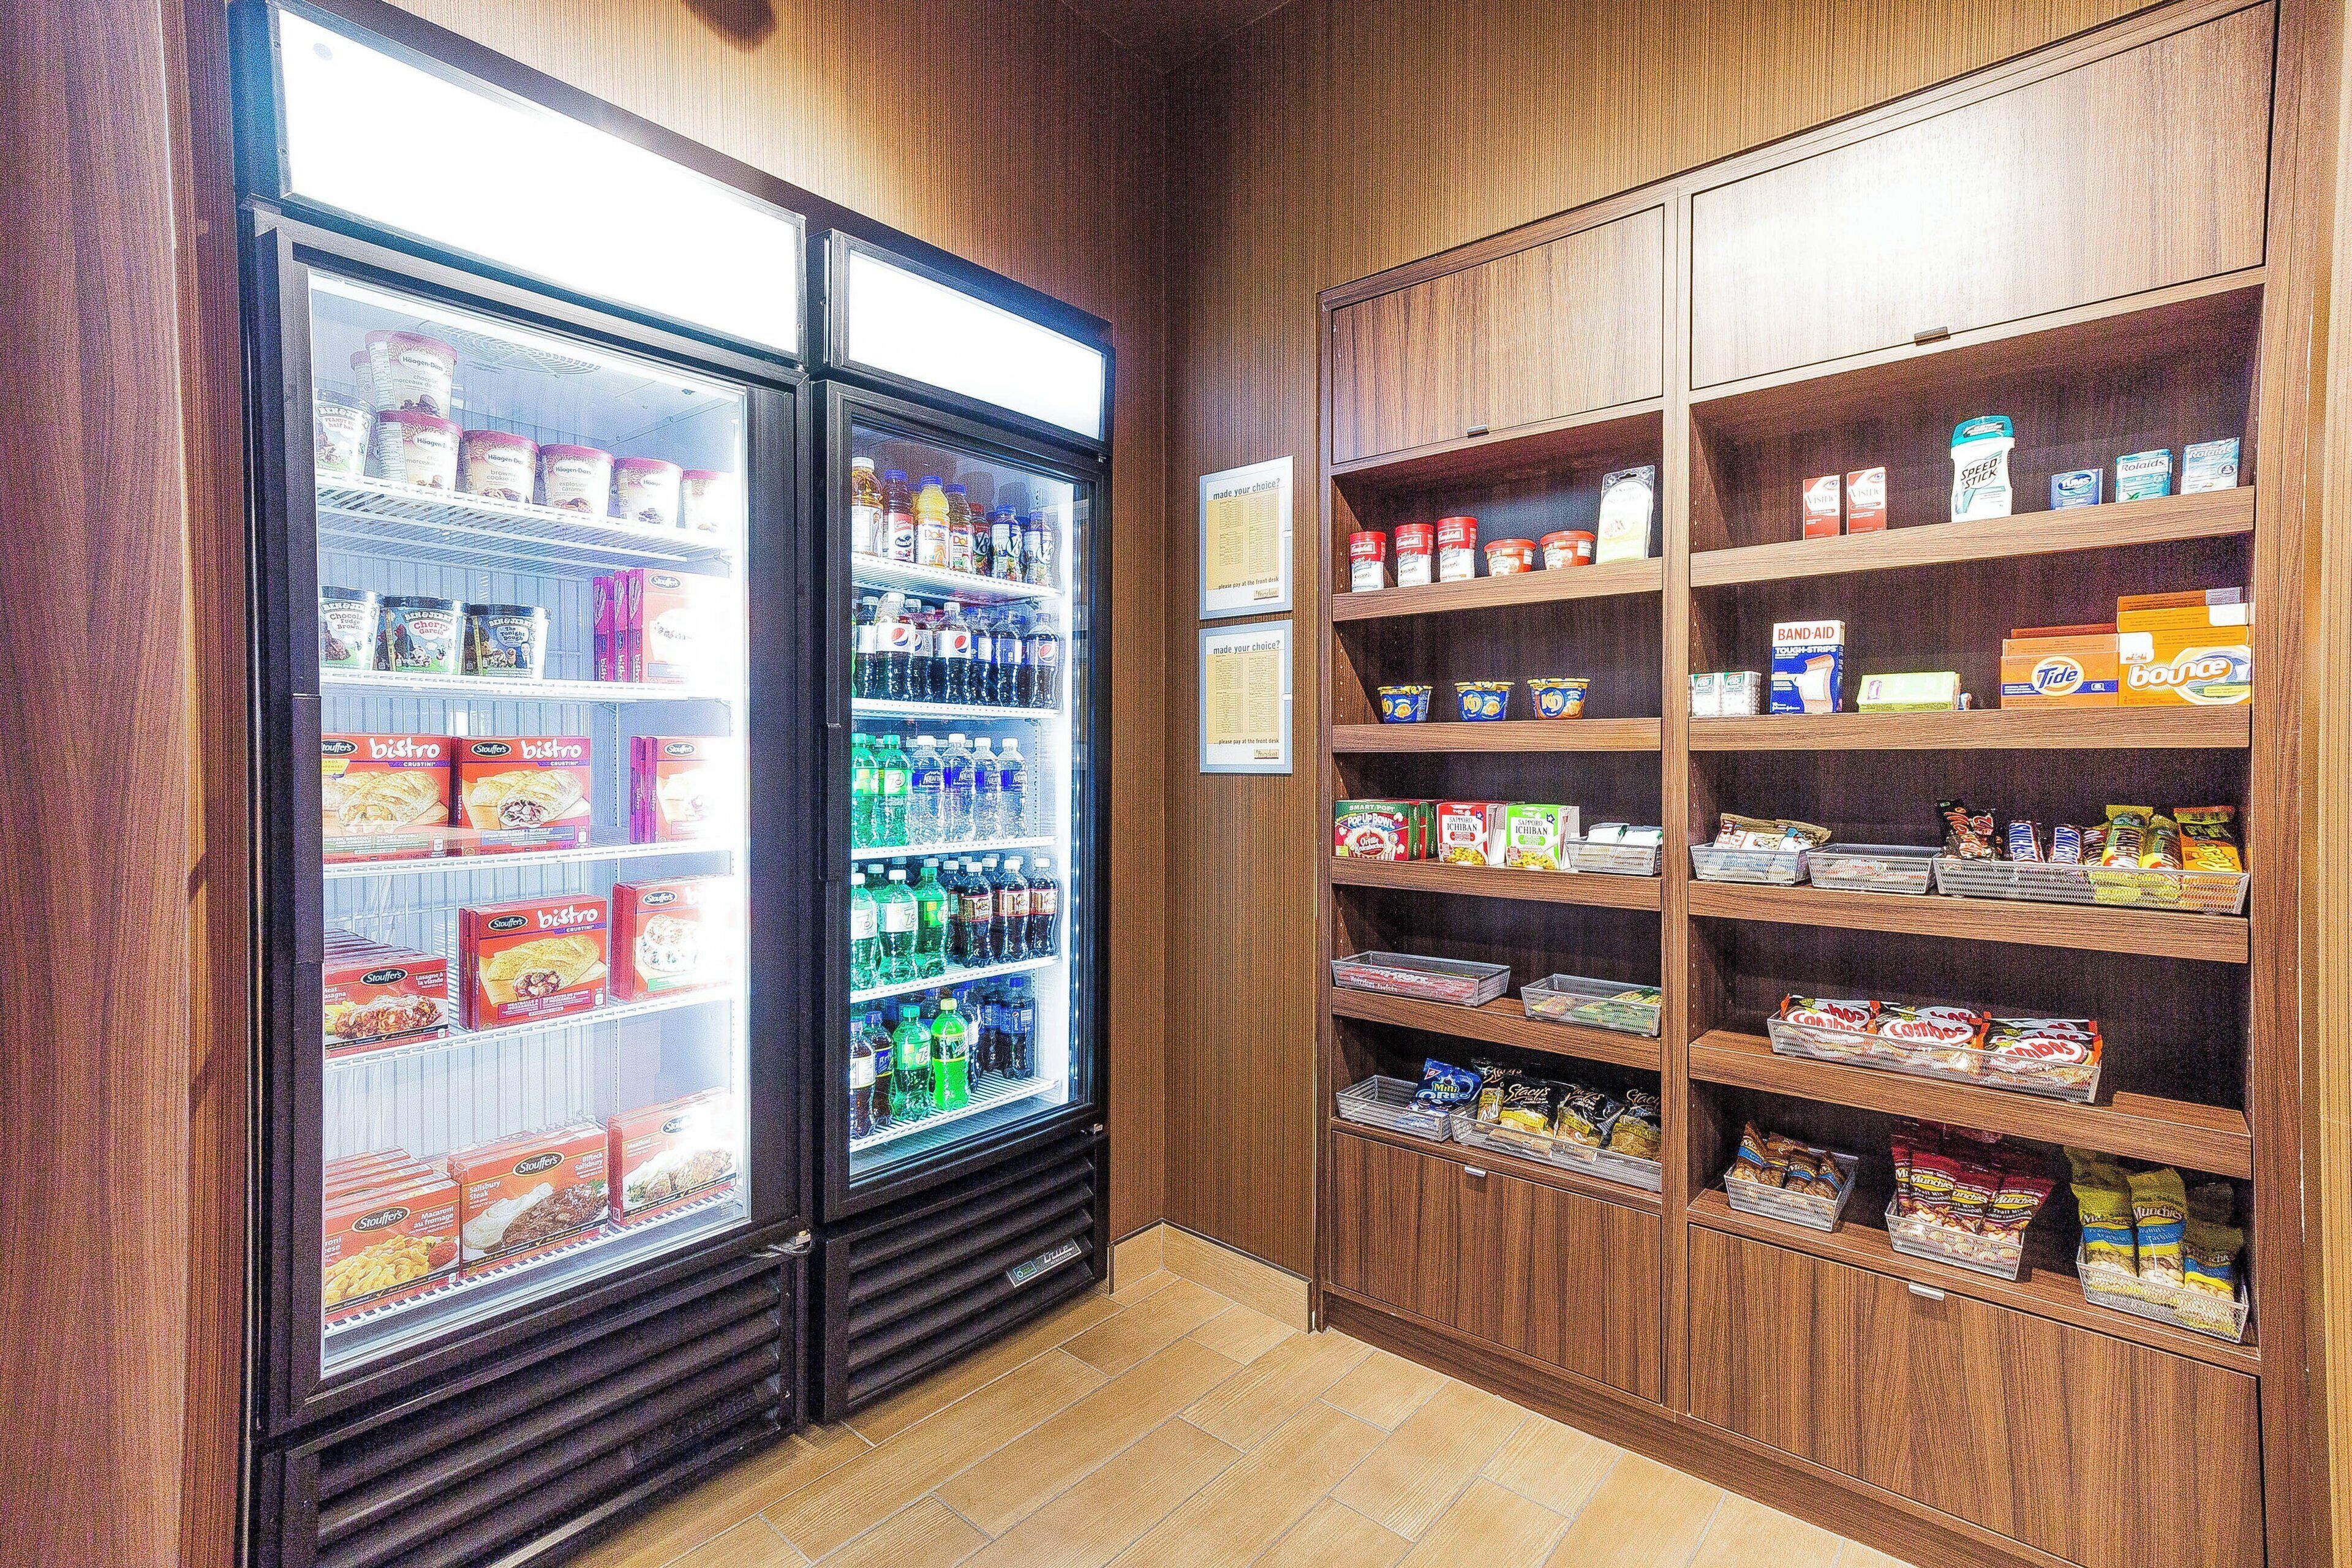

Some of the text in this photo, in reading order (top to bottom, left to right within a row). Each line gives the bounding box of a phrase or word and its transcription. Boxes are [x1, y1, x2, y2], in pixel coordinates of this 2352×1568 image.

[2189, 447, 2232, 459] Rolaids
[1961, 458, 1997, 481] SPEED
[2121, 459, 2166, 472] Rolaids
[1964, 467, 1998, 490] STICK
[2061, 477, 2091, 489] TUMS
[1213, 478, 1280, 500] made your choice?
[413, 620, 451, 632] Cherry
[1777, 627, 1834, 641] BAND-AID
[1213, 640, 1280, 655] made your choice?
[2037, 666, 2079, 690] Tide
[2129, 658, 2228, 687] bounce
[1463, 695, 1481, 712] KD
[1541, 693, 1562, 713] KD
[322, 742, 353, 755] touffer's
[369, 737, 441, 760] bistro
[476, 744, 508, 755] Stouffer's
[521, 739, 583, 760] bistro
[1348, 815, 1362, 827] POP
[1373, 815, 1395, 827] BOWL
[1447, 823, 1478, 832] ICHIBAN
[1515, 826, 1548, 835] ICHIBAN
[493, 917, 524, 929] Stouffer's
[537, 905, 599, 929] bistro
[366, 970, 402, 984] Stouffer's
[1415, 1090, 1469, 1099] OREO
[1434, 1083, 1458, 1093] Mini
[1504, 1084, 1551, 1102] Stacy's
[519, 1156, 558, 1173] Stouffer's
[469, 1182, 501, 1193] Salisbury
[1910, 1175, 1954, 1191] Munchies
[469, 1191, 489, 1200] Steak
[1952, 1191, 1988, 1204] unchies
[358, 1210, 404, 1230] Stouffer's
